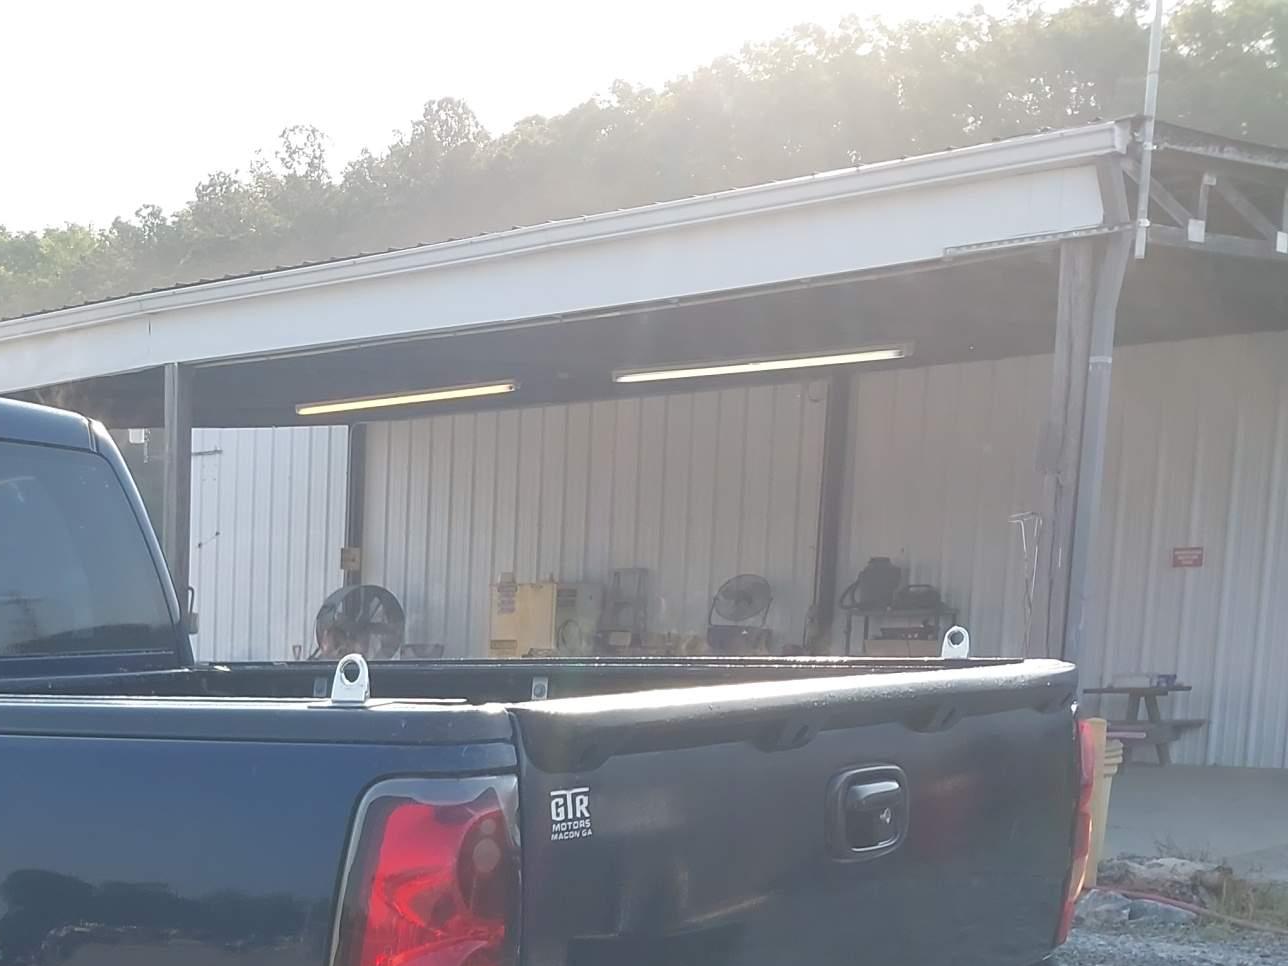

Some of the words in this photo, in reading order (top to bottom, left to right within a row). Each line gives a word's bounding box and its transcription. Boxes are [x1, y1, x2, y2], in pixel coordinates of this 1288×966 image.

[550, 787, 590, 821] GTR
[552, 819, 591, 832] MOTORS
[551, 830, 580, 841] MACON
[581, 828, 593, 837] GA
